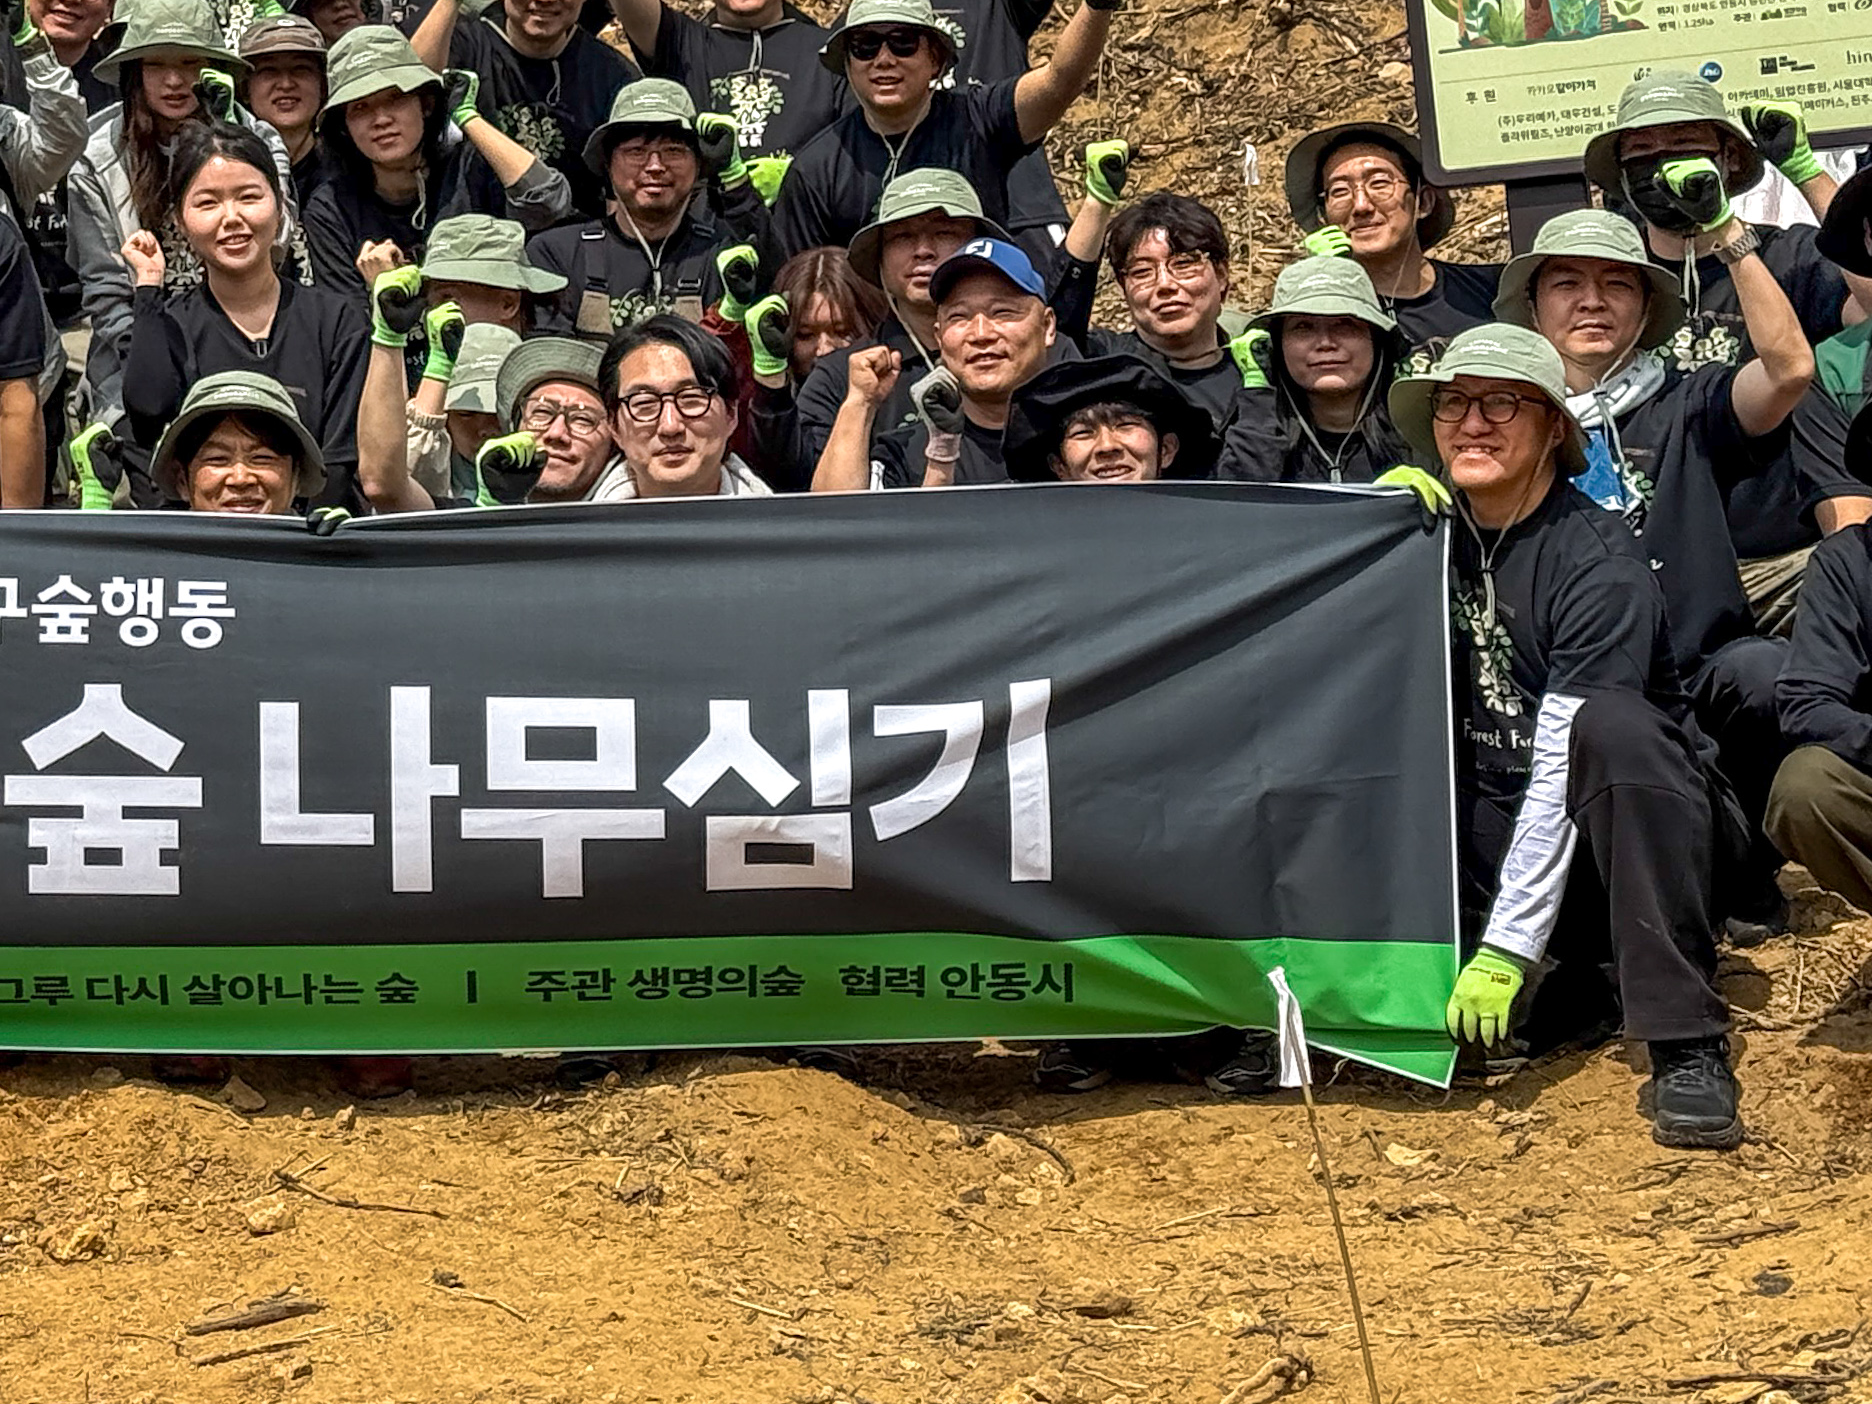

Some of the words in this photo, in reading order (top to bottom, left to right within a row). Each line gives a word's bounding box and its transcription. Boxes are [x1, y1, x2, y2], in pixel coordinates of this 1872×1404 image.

[259, 677, 1053, 899] 나무심기
[85, 972, 170, 1006] 다시
[181, 971, 366, 1006] 살아나는
[374, 971, 421, 1004] 숲
[524, 966, 617, 1002] 주관
[627, 964, 806, 1000] 생명의숲
[838, 964, 926, 998] 협력
[939, 962, 1074, 1003] 안동시
